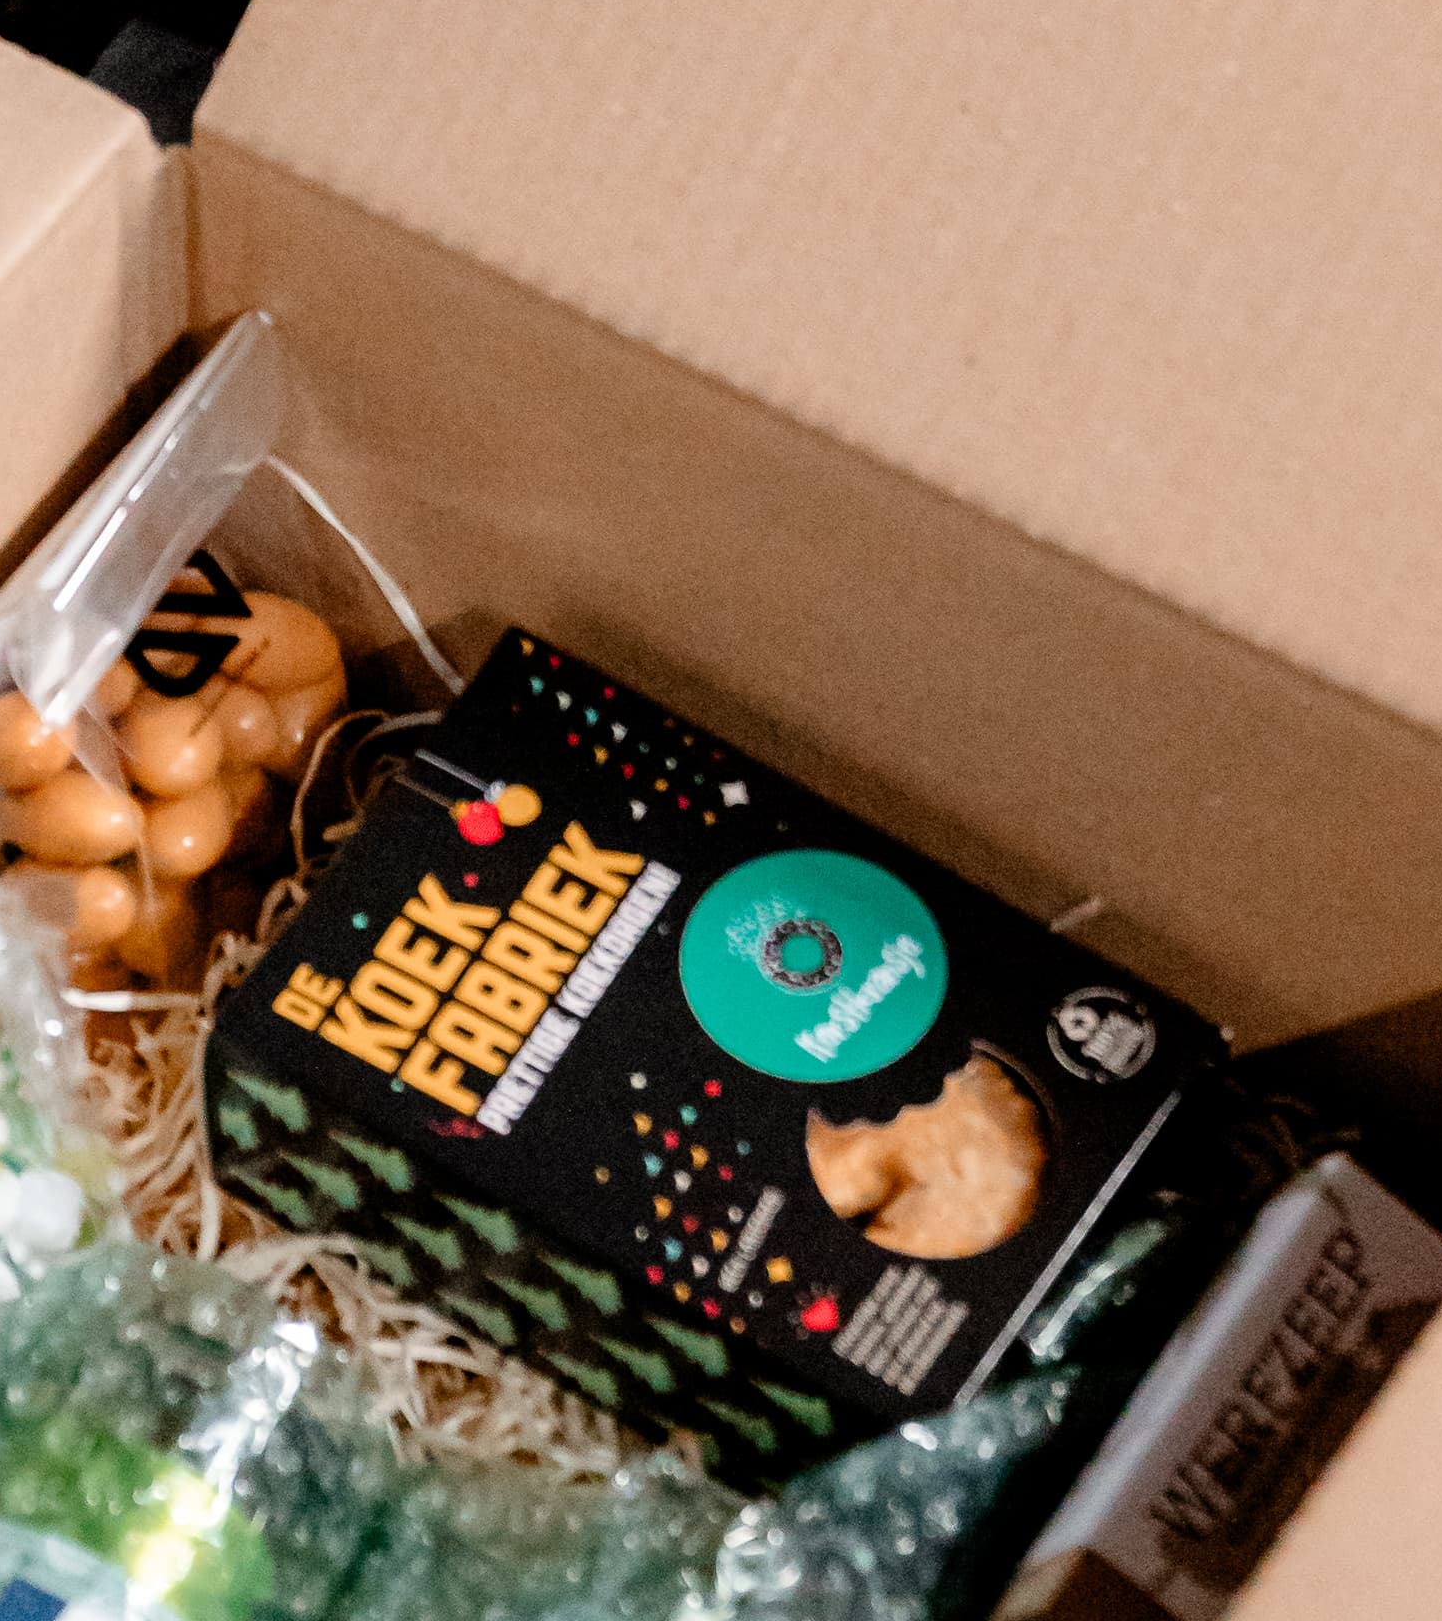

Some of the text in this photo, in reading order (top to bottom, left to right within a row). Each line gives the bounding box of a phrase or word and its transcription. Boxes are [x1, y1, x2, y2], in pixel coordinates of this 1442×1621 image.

[273, 963, 343, 1031] DE
[319, 874, 502, 1075] KOEK
[399, 821, 644, 1116] FABRIEK
